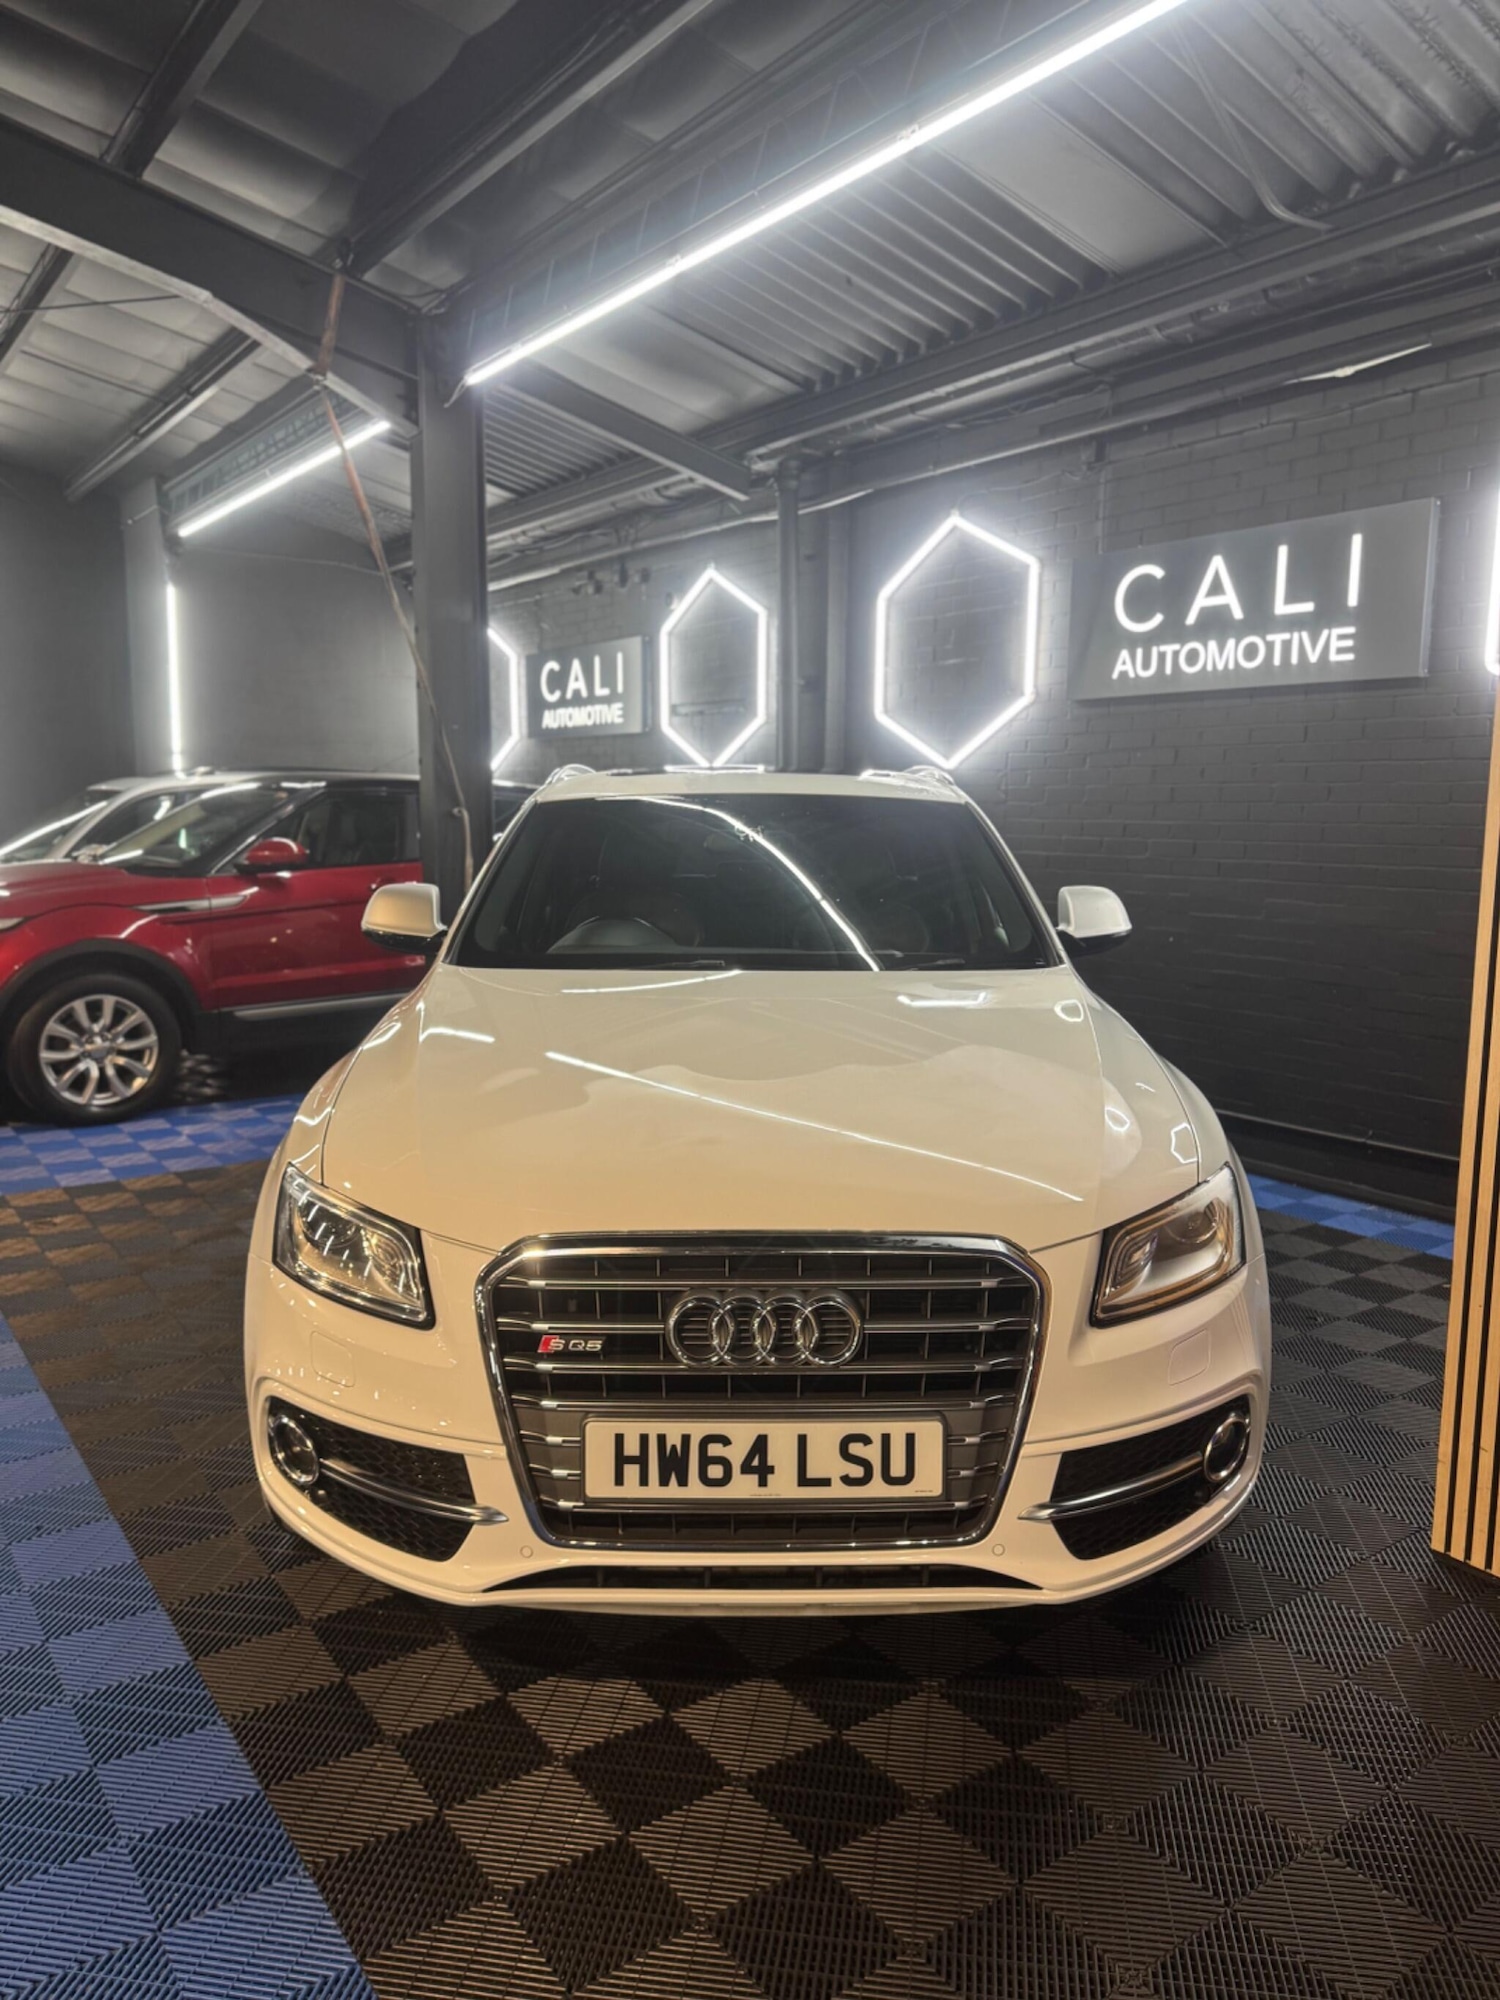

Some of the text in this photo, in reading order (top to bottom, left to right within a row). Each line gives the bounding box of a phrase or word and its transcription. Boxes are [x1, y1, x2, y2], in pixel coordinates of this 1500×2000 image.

[1114, 533, 1363, 633] CALI
[540, 651, 624, 703] CALI
[1111, 626, 1356, 680] AUTOMOTIVE
[541, 702, 624, 729] AUTOMOTIVE
[548, 1338, 603, 1352] SQ5
[613, 1432, 916, 1487] HW64 LSU
